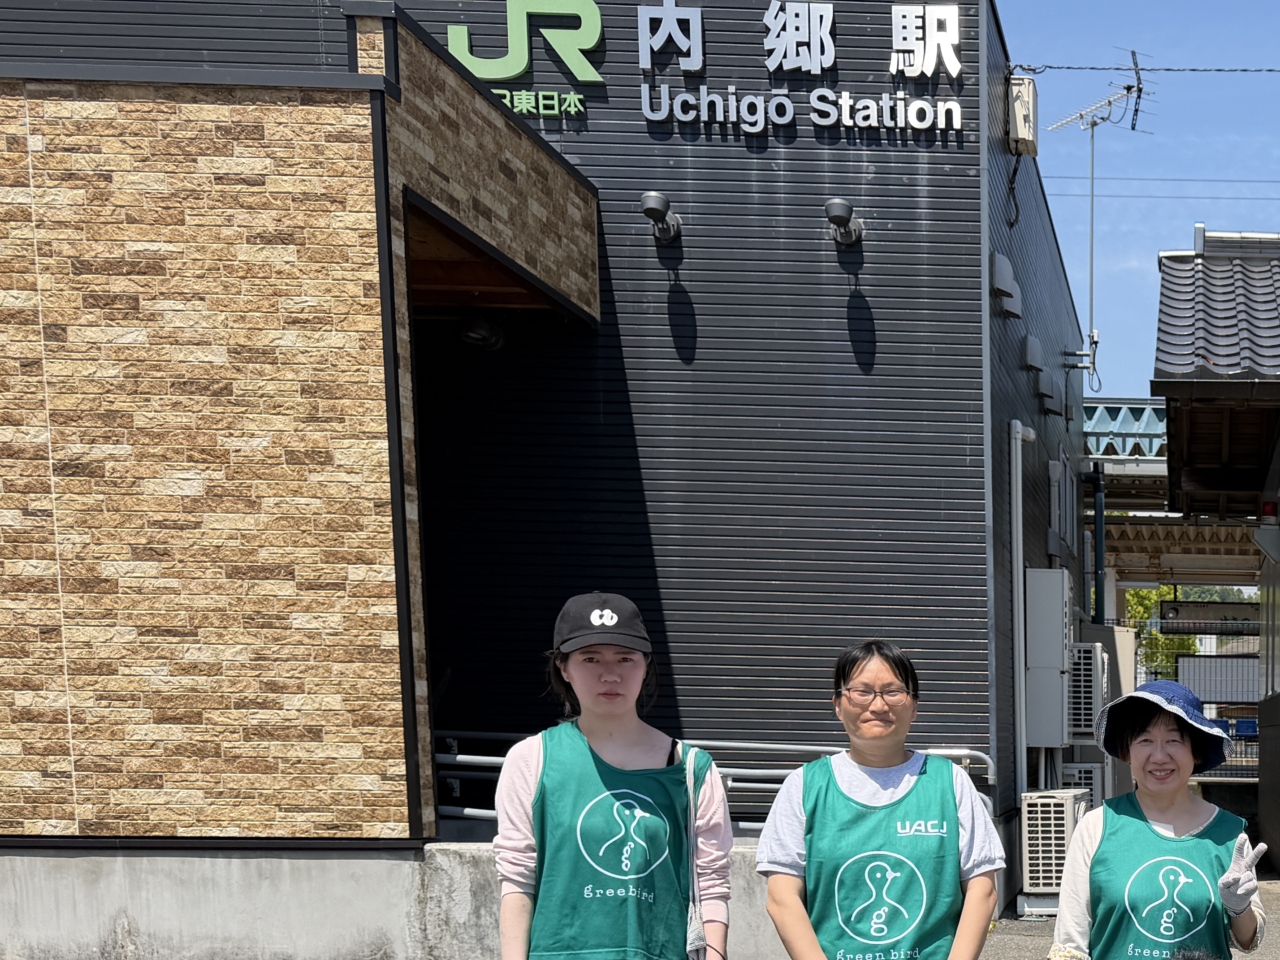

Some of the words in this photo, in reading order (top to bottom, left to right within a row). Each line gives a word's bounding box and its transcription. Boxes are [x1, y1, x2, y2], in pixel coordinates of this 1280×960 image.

[447, 0, 604, 81] JR
[637, 0, 962, 78] 内郷駅
[490, 89, 585, 115] R東日本
[810, 88, 962, 129] Station
[896, 820, 947, 836] UACJ
[890, 948, 921, 960] bird
[1128, 943, 1170, 958] green
